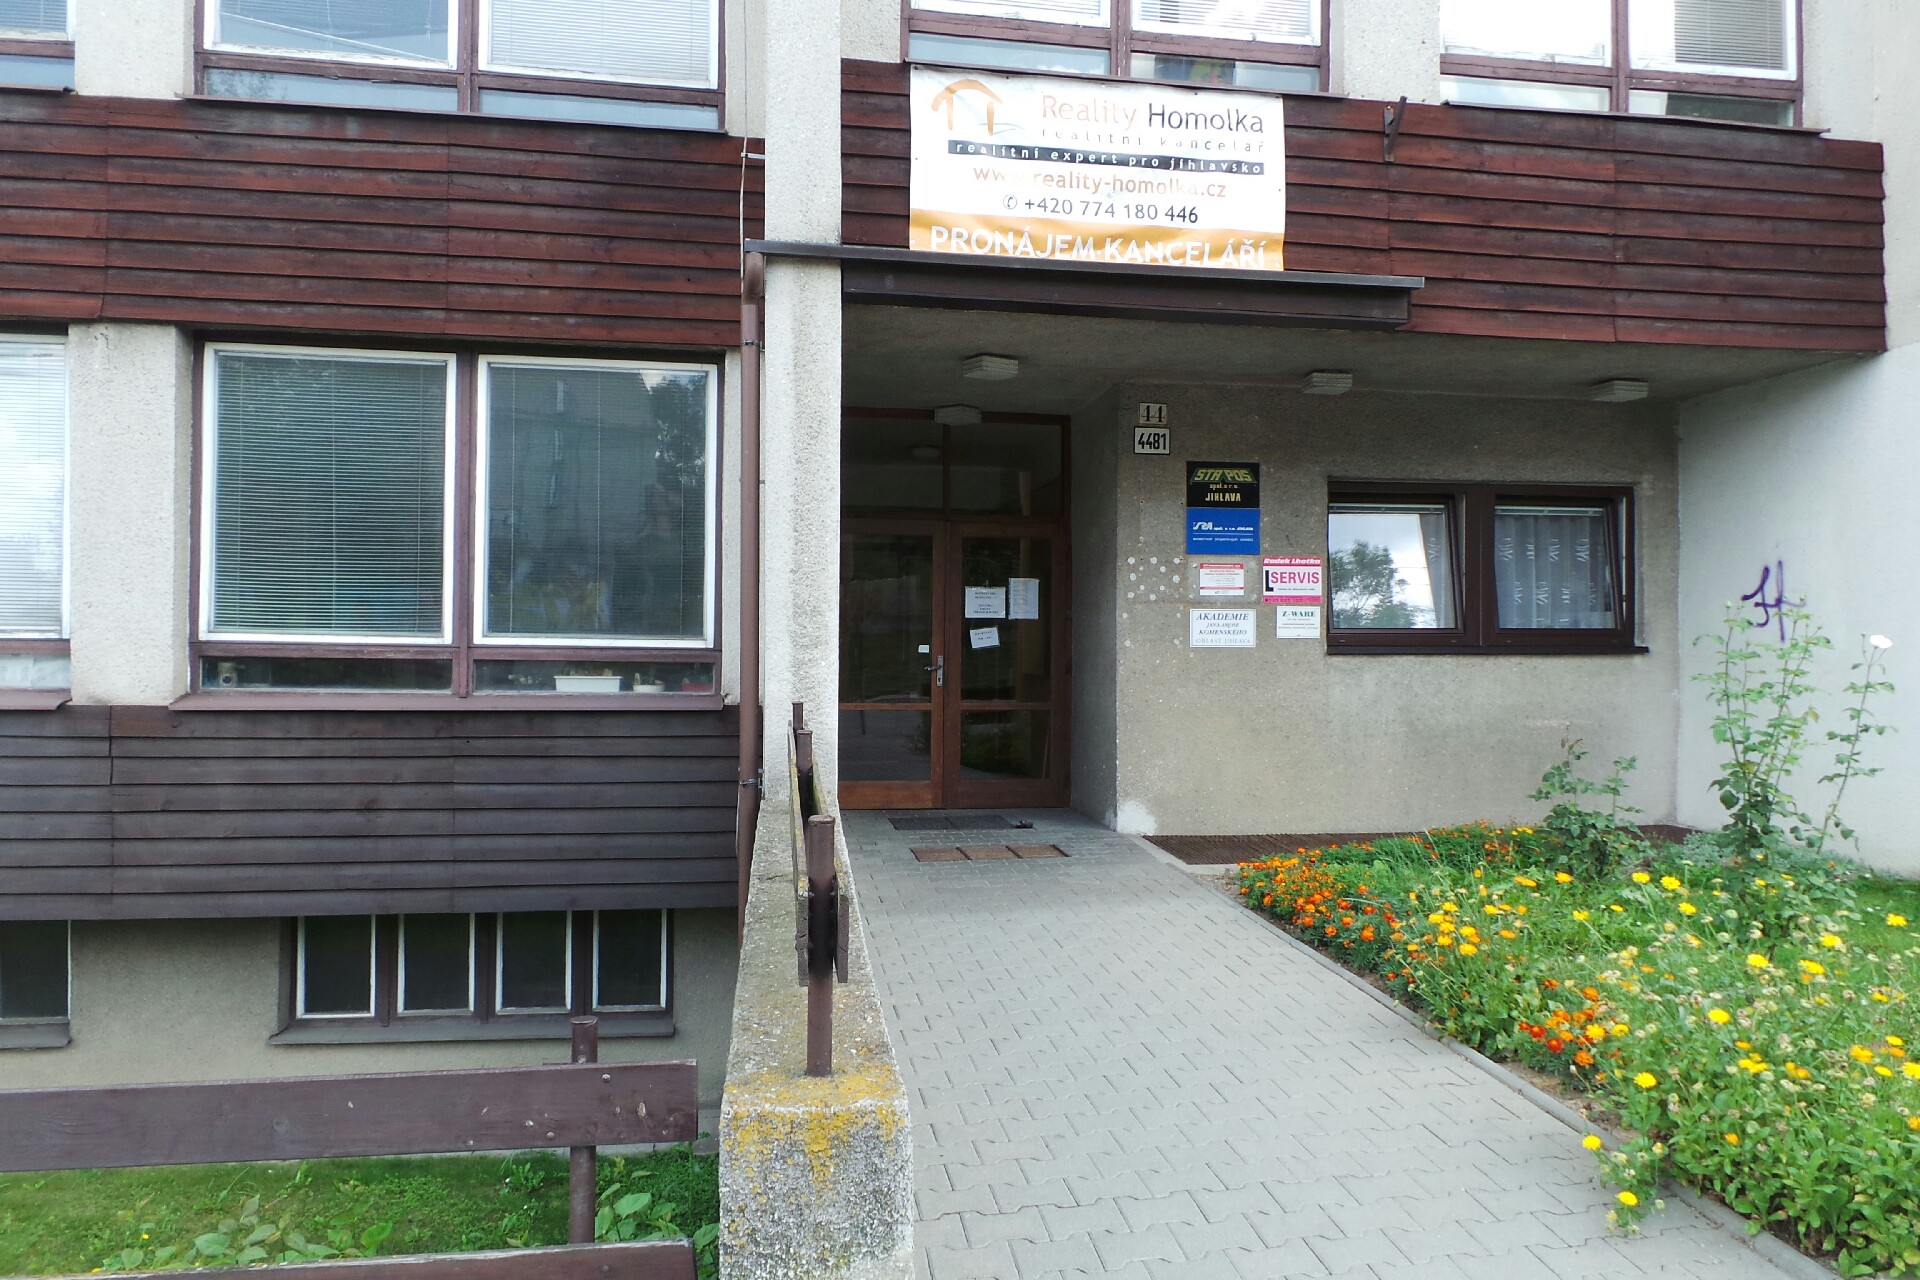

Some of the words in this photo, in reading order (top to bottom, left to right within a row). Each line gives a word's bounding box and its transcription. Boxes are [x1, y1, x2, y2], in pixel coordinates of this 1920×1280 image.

[1042, 94, 1137, 131] Reality
[1148, 103, 1264, 133] Homolka
[956, 143, 1039, 159] realitní
[1050, 149, 1117, 164] expert
[1129, 156, 1160, 167] pro
[1169, 157, 1261, 174] jihlavsko
[1024, 197, 1074, 216] +420
[1079, 200, 1116, 218] 774
[1123, 203, 1158, 220] 180
[1164, 205, 1199, 224] 446
[930, 225, 1097, 260] PRONÁJEM
[1103, 237, 1268, 269] KANCELÁŘÍ
[1137, 432, 1167, 450] 4481
[1205, 492, 1242, 502] JIHLAVA
[1270, 571, 1320, 584] SERVIS
[1196, 612, 1249, 621] AKADEMIE
[1282, 610, 1316, 618] Z-WARE
[1198, 628, 1248, 636] KOMENSKÉHO
